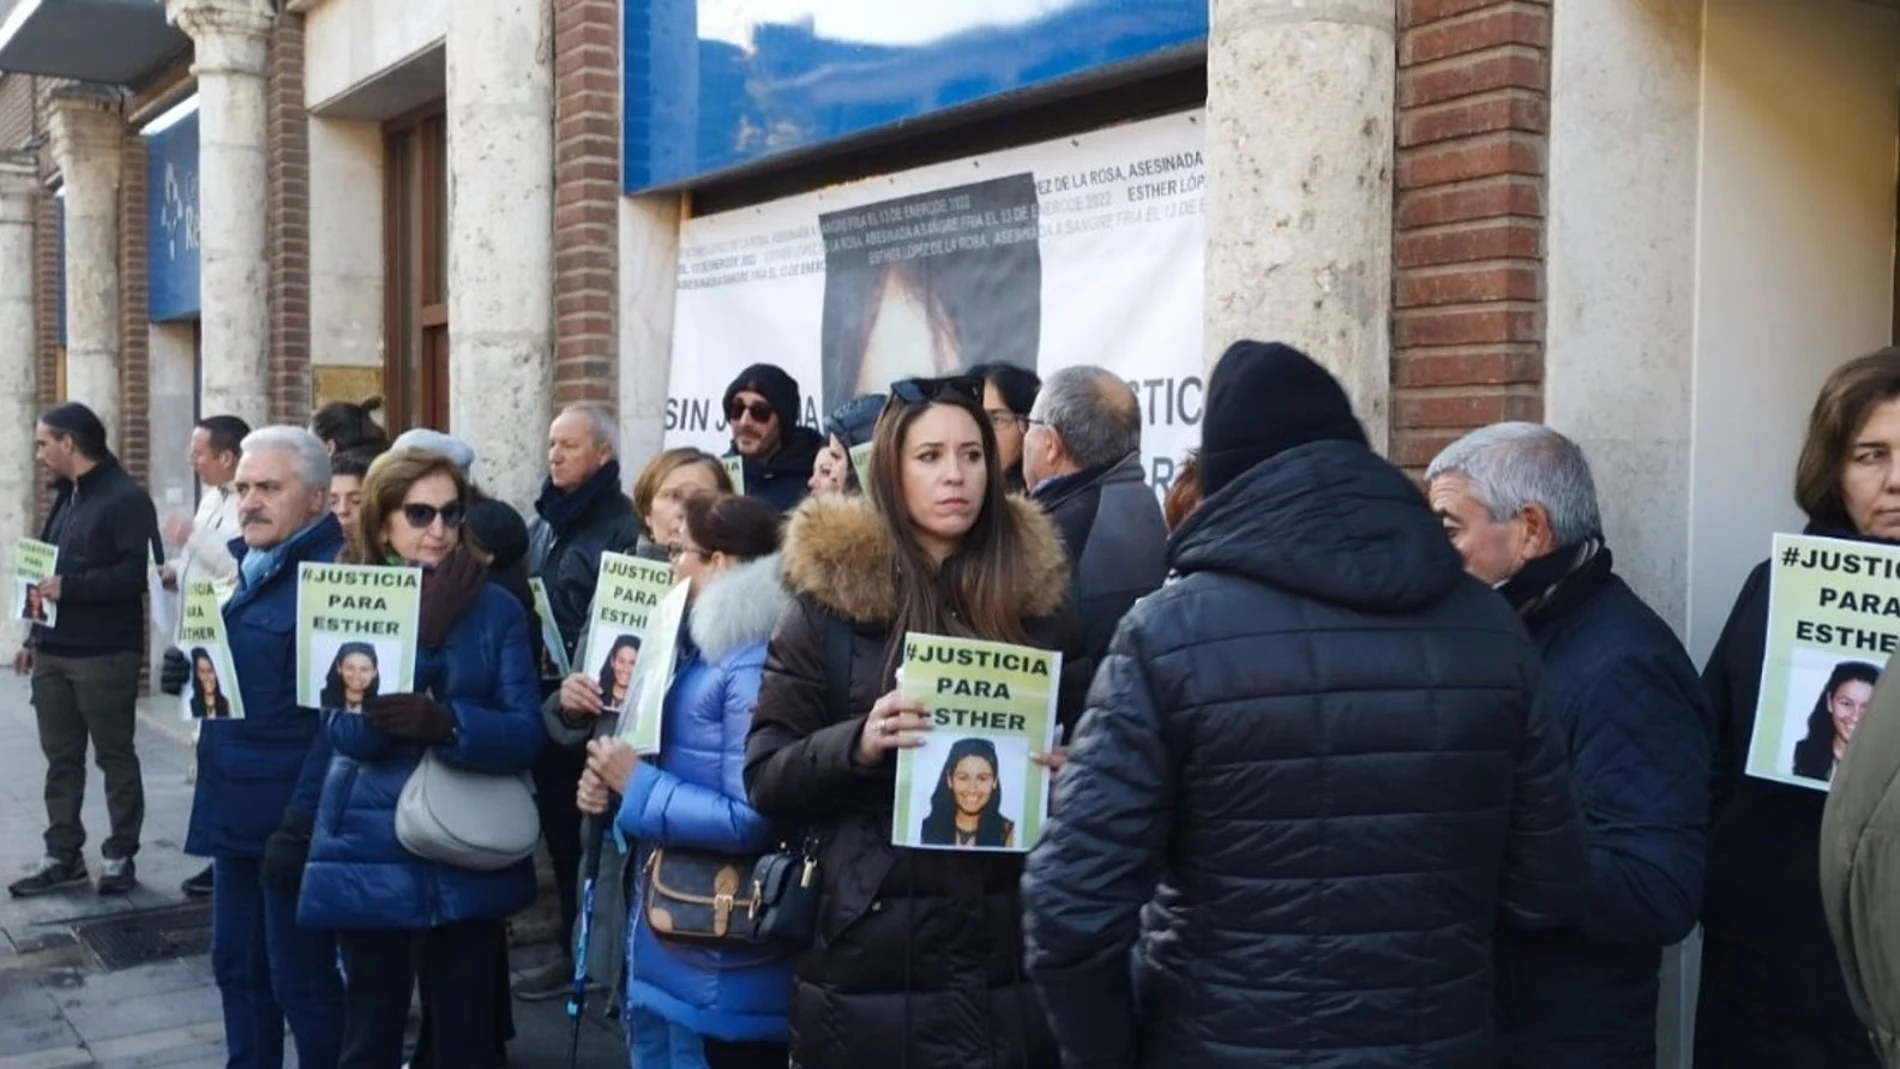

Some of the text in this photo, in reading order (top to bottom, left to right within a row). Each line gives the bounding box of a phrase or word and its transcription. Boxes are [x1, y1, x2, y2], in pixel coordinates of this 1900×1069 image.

[1054, 178, 1070, 193] DE
[1072, 173, 1088, 190] LA
[1088, 166, 1127, 186] ROSA,
[1128, 150, 1204, 178] ASESINADA
[1127, 180, 1177, 203] ESTHER
[665, 397, 710, 432] SIN
[602, 558, 676, 586] #JUSTICI
[1782, 546, 1900, 580] #JUSTI
[301, 567, 417, 588] #JUSTICIA
[328, 593, 387, 611] PARA
[613, 585, 658, 607] PARA
[1818, 587, 1900, 619] PARA
[312, 616, 400, 635] ESTHER
[1796, 620, 1899, 653] ESTHE
[905, 642, 1049, 677] #JUSTICIA
[936, 676, 1011, 700] PARA
[927, 707, 1027, 731] STHER
